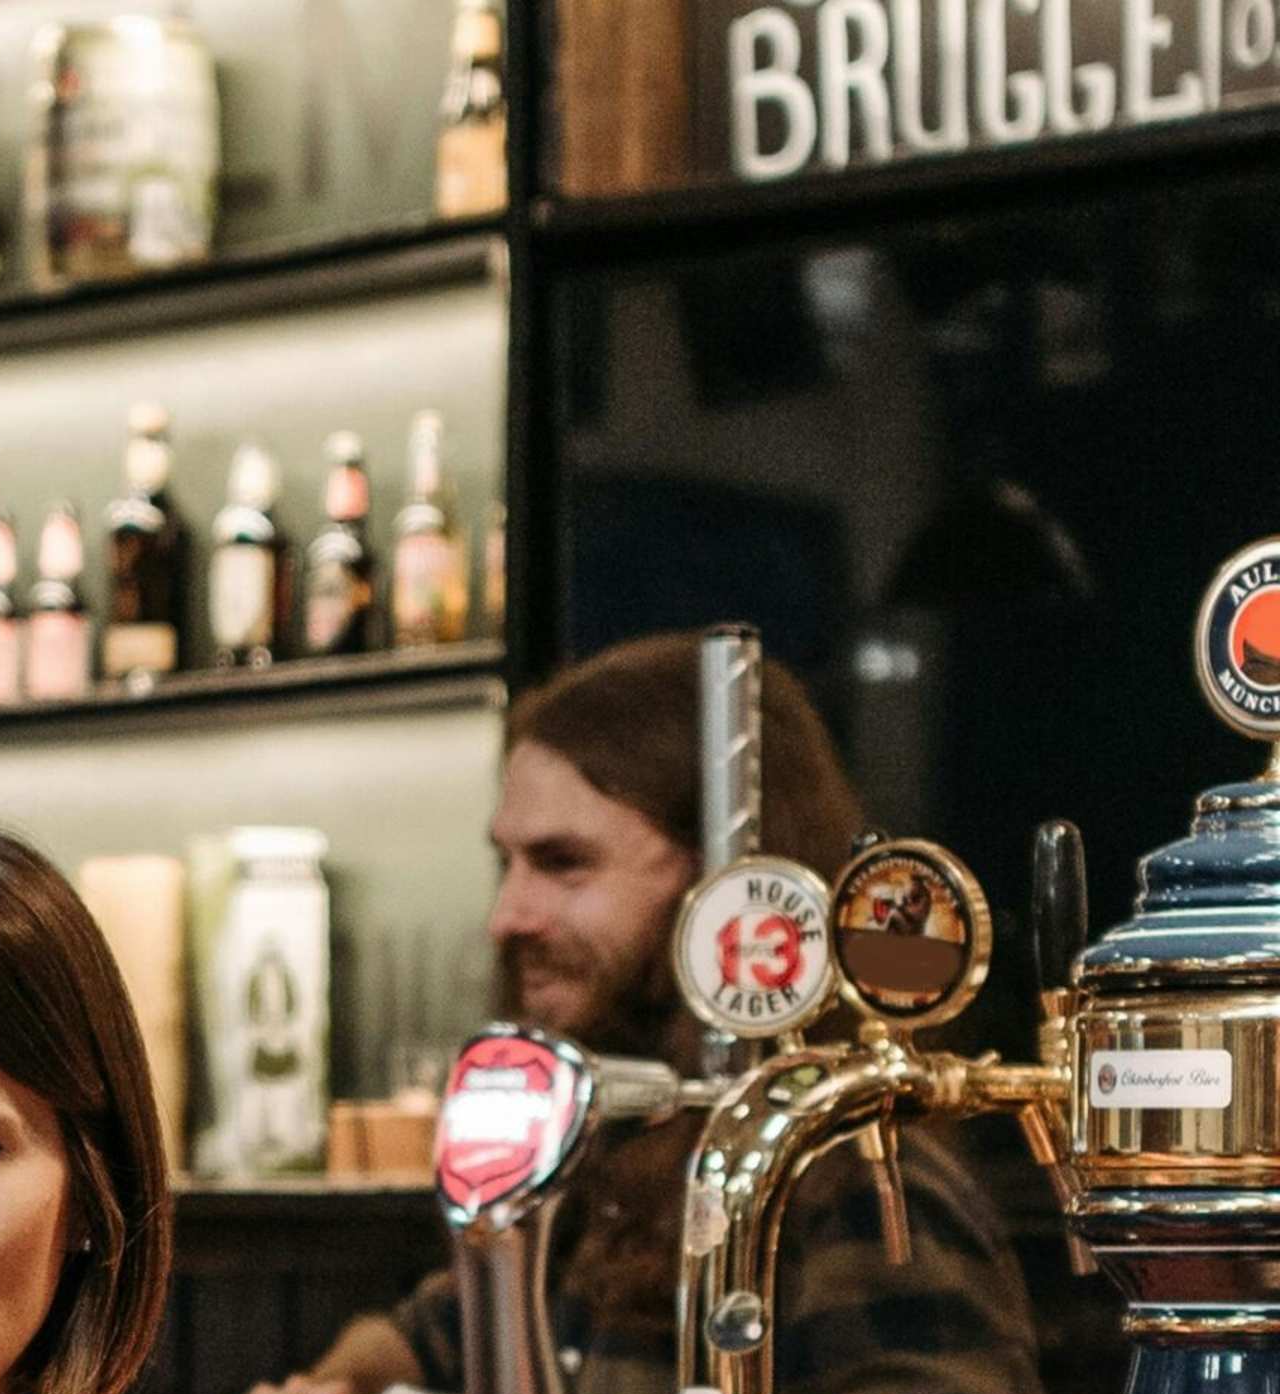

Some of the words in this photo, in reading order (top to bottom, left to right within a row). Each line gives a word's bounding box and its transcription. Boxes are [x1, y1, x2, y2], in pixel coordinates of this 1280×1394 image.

[747, 878, 822, 942] HOUSE
[717, 913, 803, 990] 13
[712, 980, 801, 1018] LAGER
